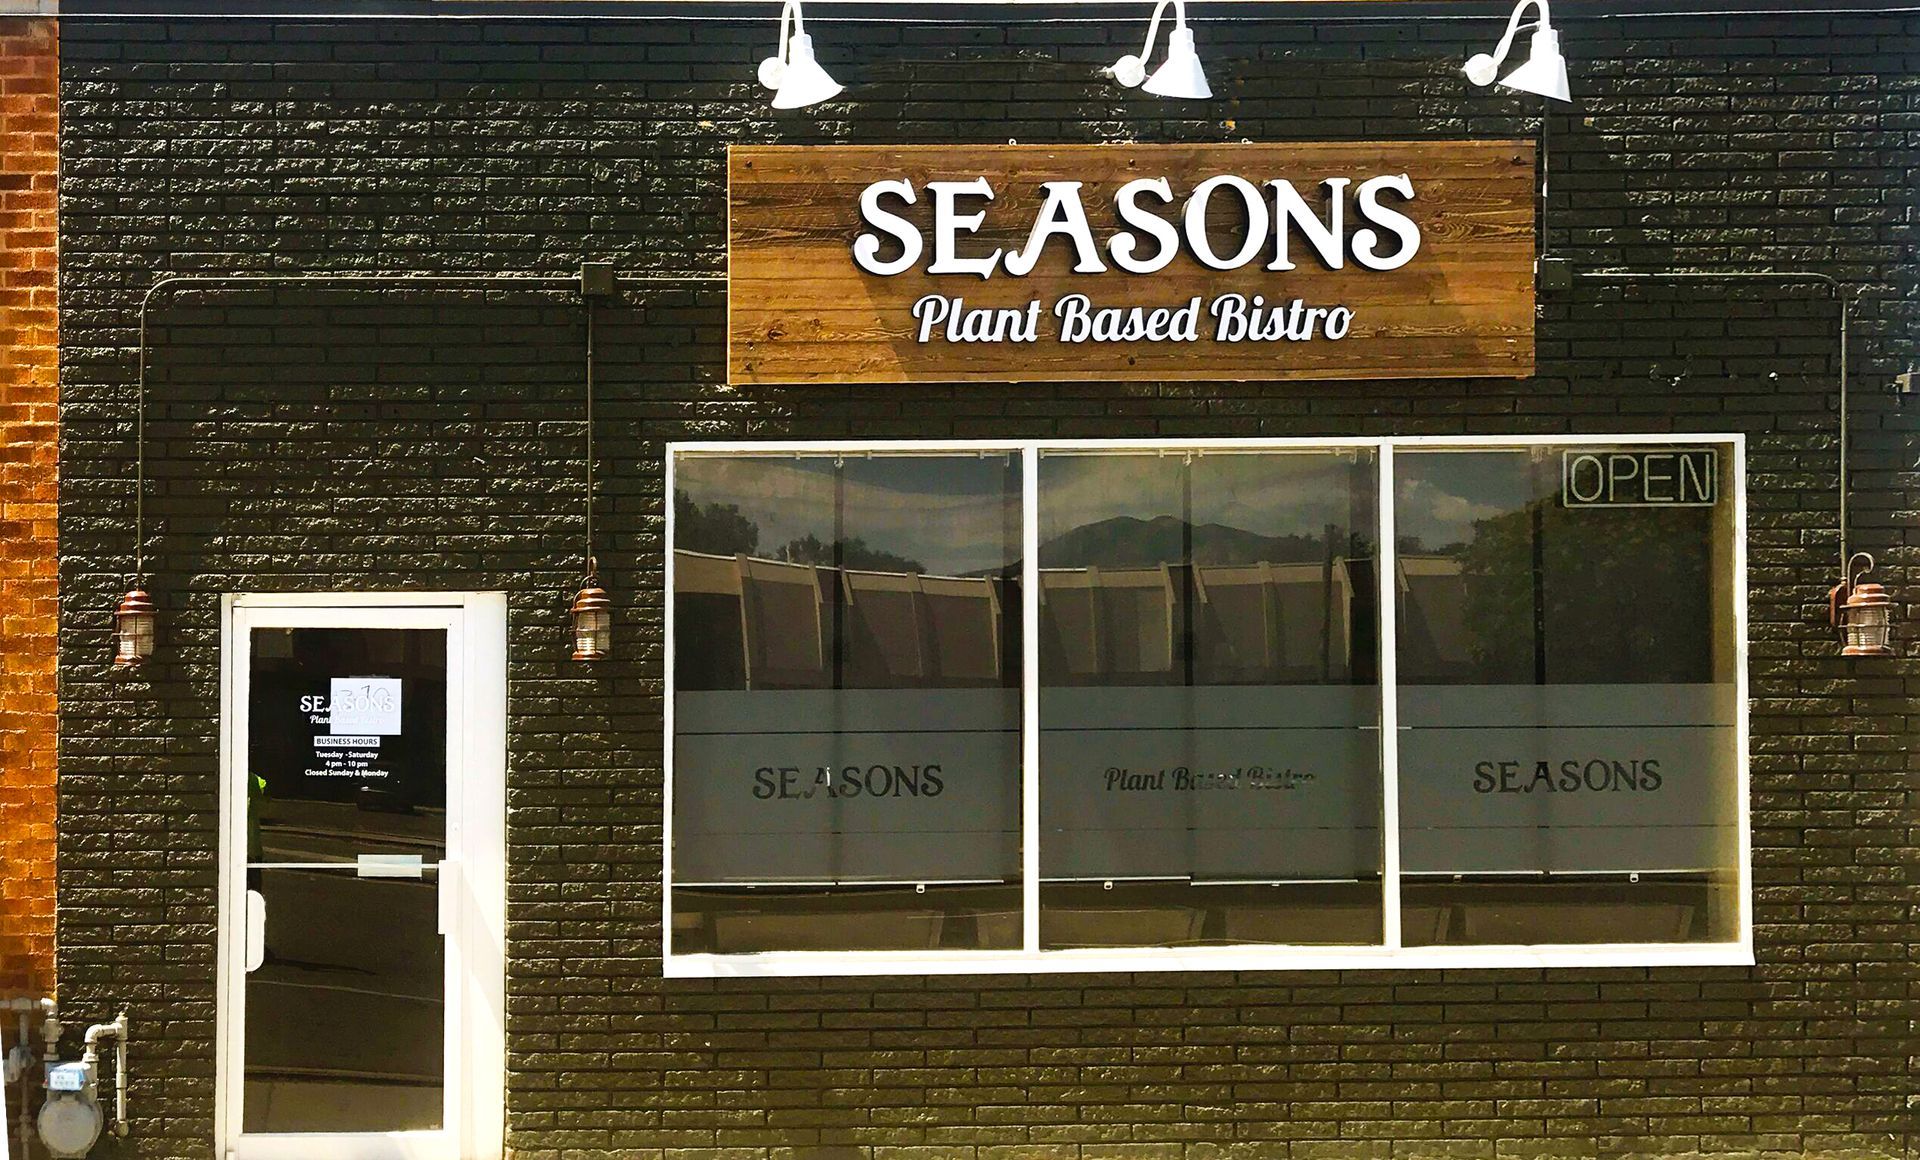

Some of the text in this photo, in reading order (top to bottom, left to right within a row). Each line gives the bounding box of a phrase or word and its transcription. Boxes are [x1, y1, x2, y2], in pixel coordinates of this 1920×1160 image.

[853, 173, 1421, 280] SEASONS
[912, 293, 1356, 343] Plant Based Bistro
[1571, 454, 1710, 502] OPEN
[315, 751, 343, 760] Tuesday
[328, 769, 354, 778] Sunday
[361, 770, 389, 778] Monday
[752, 765, 944, 799] SEASONS
[1104, 767, 1166, 791] Plant
[1473, 760, 1662, 793] SEASONS
